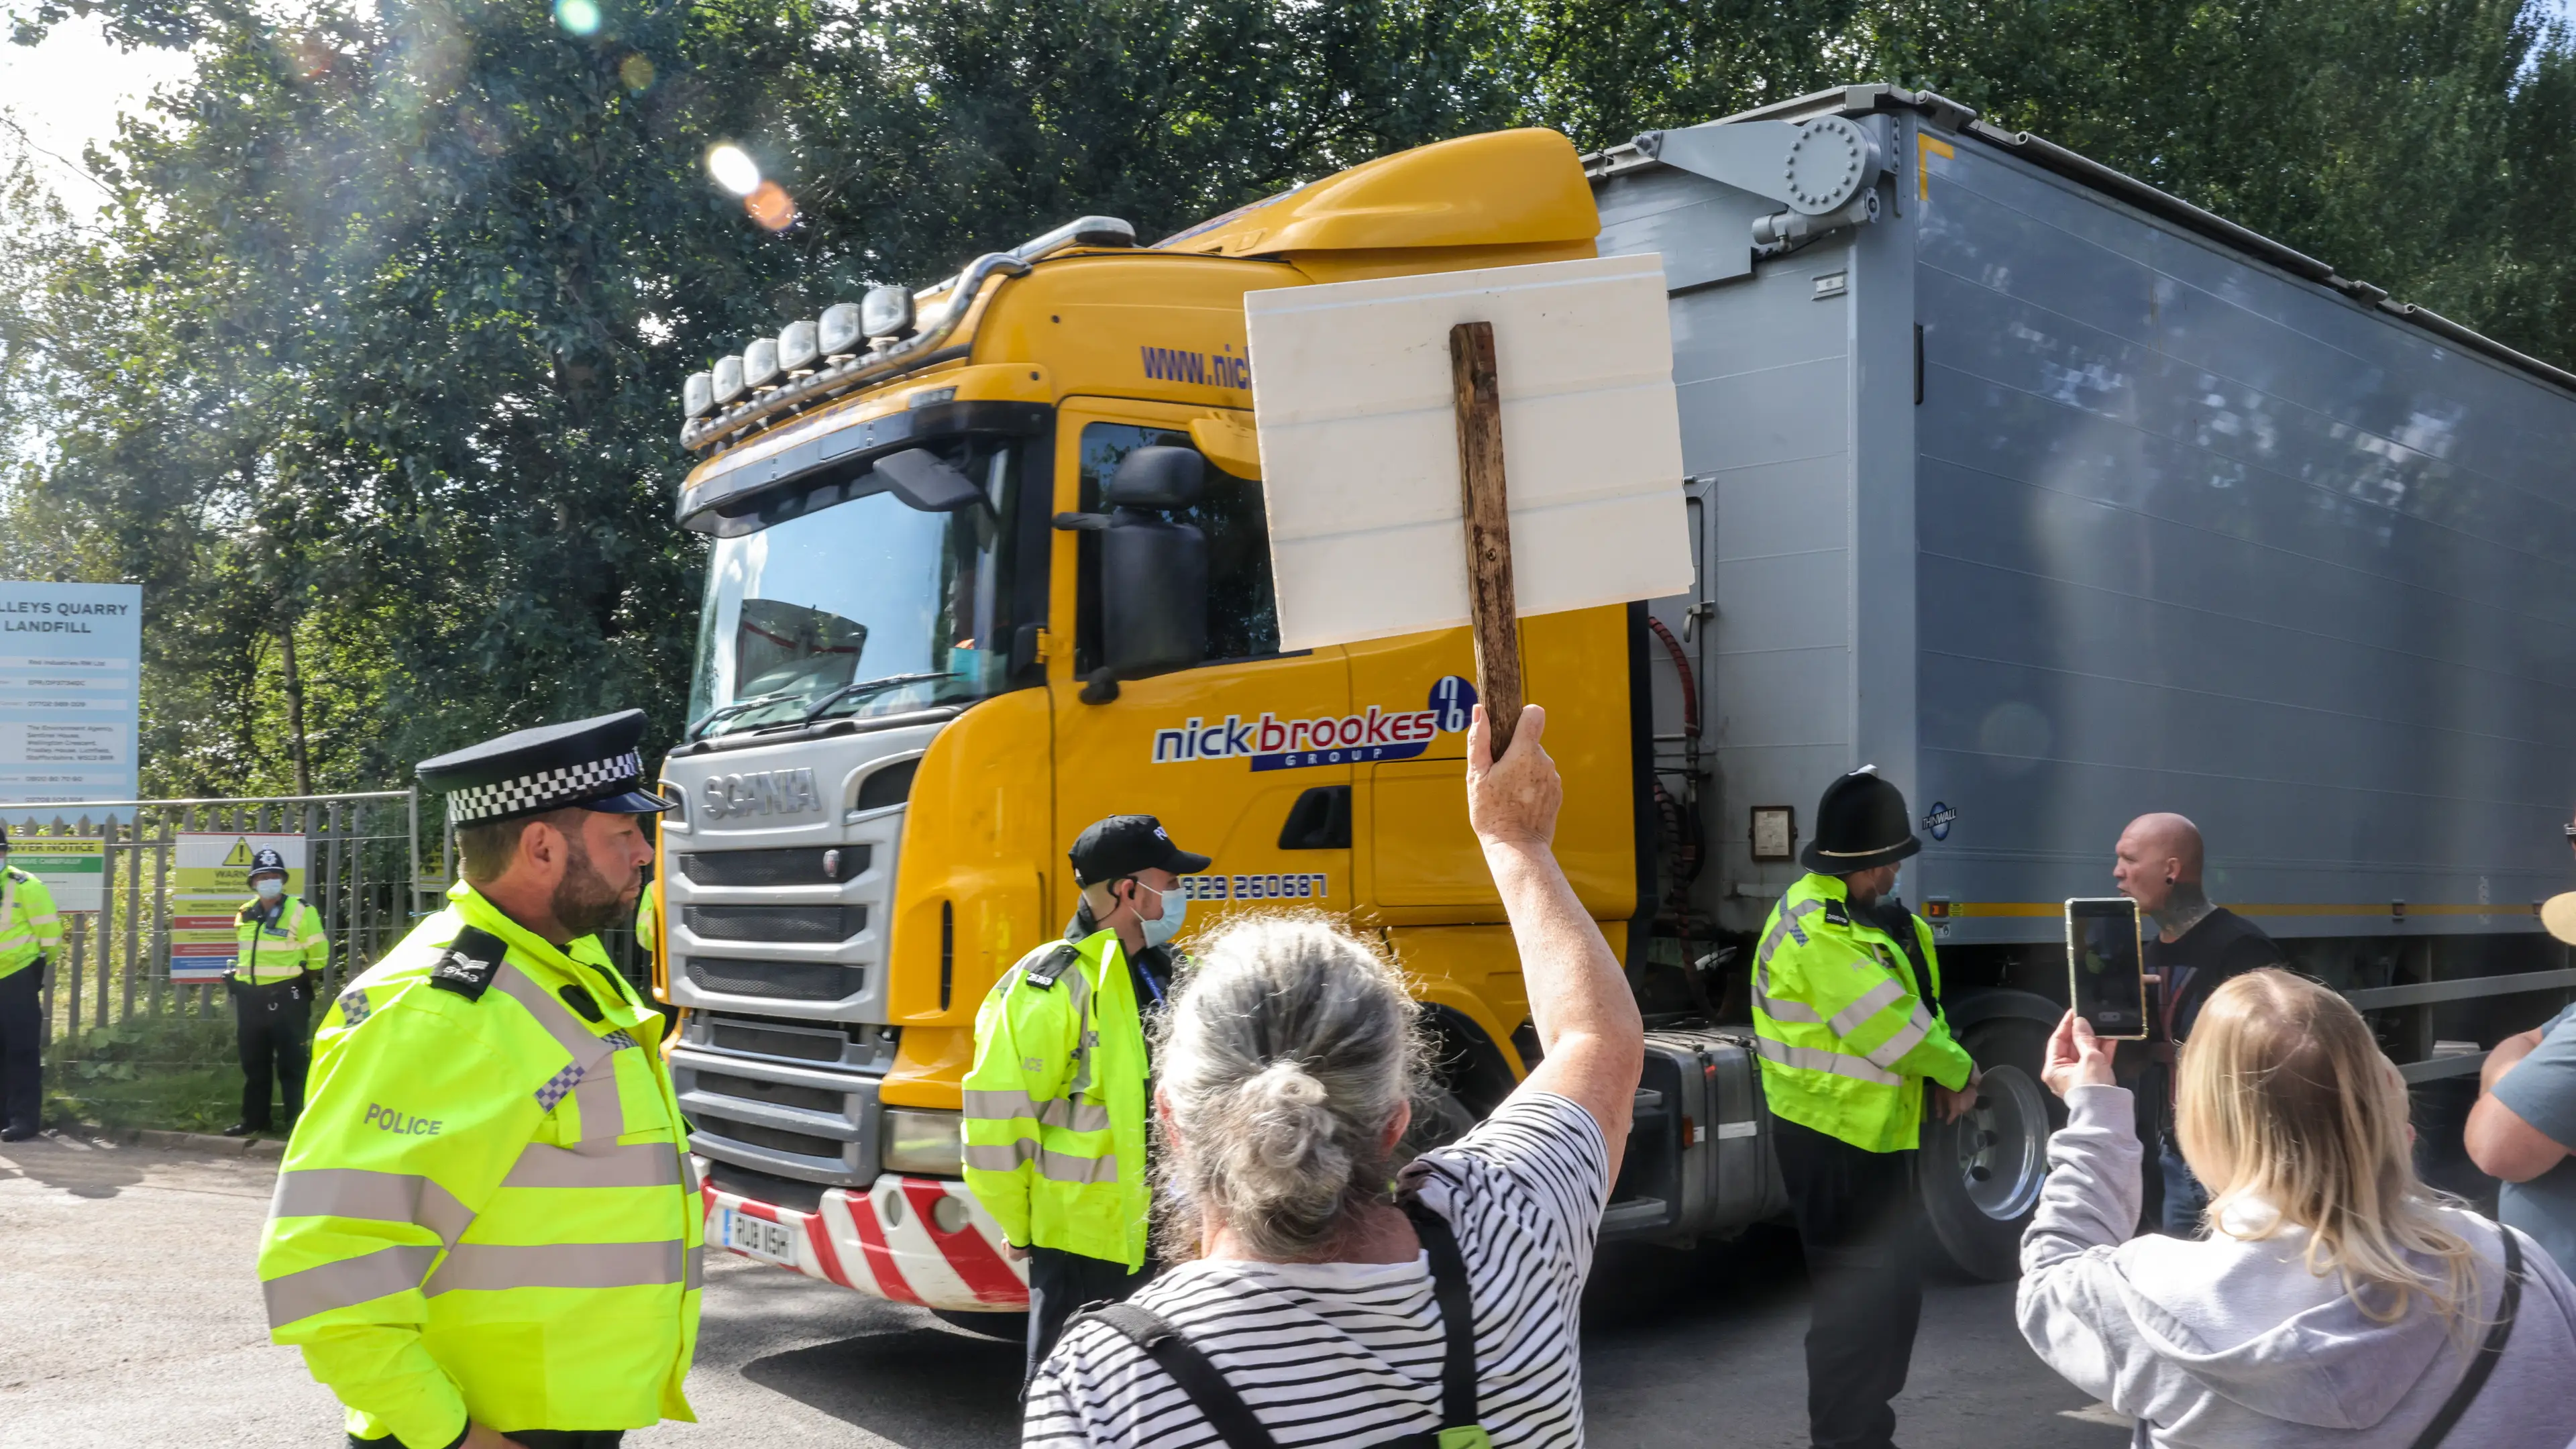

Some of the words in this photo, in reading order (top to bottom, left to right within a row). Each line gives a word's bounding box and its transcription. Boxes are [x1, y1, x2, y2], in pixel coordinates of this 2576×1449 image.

[57, 602, 128, 616] QUARRY
[5, 621, 92, 633] LANDFILL
[1285, 749, 1383, 766] GROUP
[702, 767, 822, 820] SCANIA
[1923, 808, 1956, 829] THINWALL
[46, 843, 95, 851] NOTICE
[1232, 873, 1328, 900] 260687
[364, 1103, 443, 1135] POLICE
